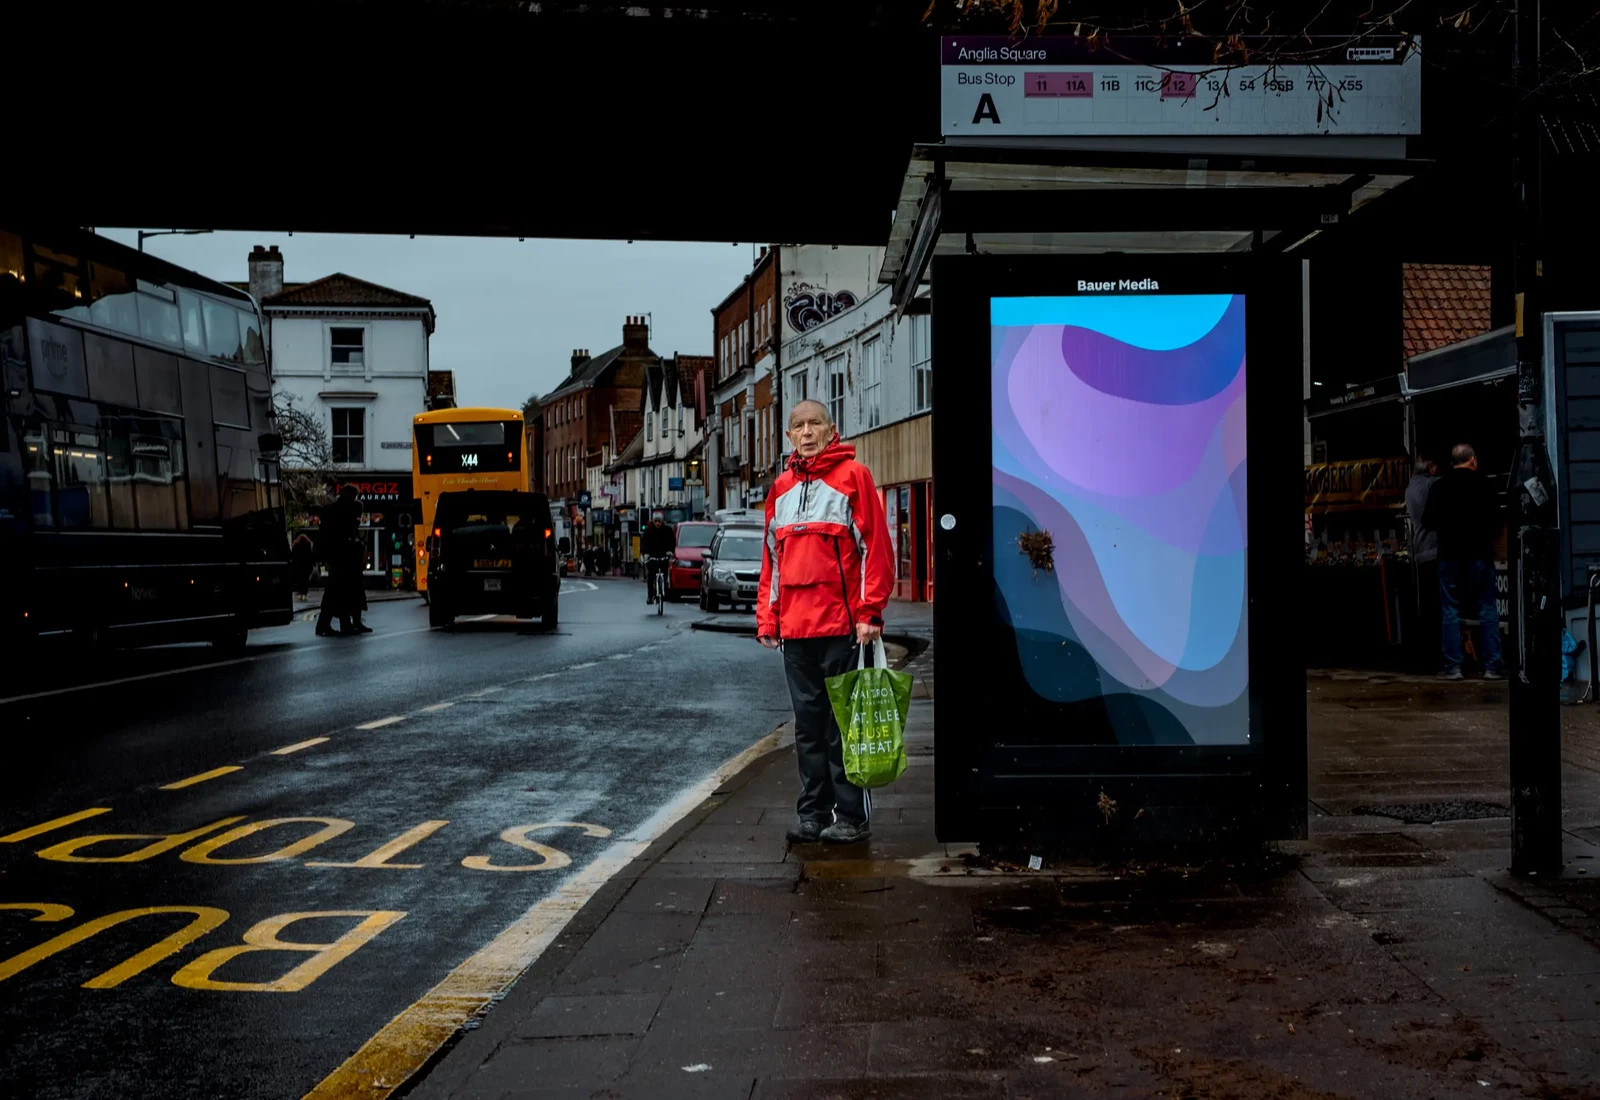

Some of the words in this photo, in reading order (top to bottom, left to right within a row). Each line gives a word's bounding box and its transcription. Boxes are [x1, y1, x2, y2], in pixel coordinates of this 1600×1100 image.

[958, 47, 998, 62] Anglia
[1000, 47, 1047, 62] Square
[957, 72, 983, 85] Bus
[984, 72, 1016, 87] Stop
[1037, 80, 1047, 91] 11
[1066, 80, 1086, 91] 11A
[1101, 80, 1120, 91] 11B
[1134, 80, 1154, 91] 11C
[1173, 80, 1185, 91] 12
[1207, 80, 1220, 91] 13
[1239, 80, 1256, 91] 54
[1306, 80, 1326, 91] 717
[1339, 80, 1363, 91] X55
[972, 93, 1001, 124] A
[1077, 279, 1116, 292] Bauer
[1118, 278, 1159, 291] Media
[41, 337, 68, 364] prime
[461, 453, 479, 467] X44
[873, 708, 899, 723] SLEE
[36, 815, 612, 872] STOP
[0, 902, 407, 992] BU
